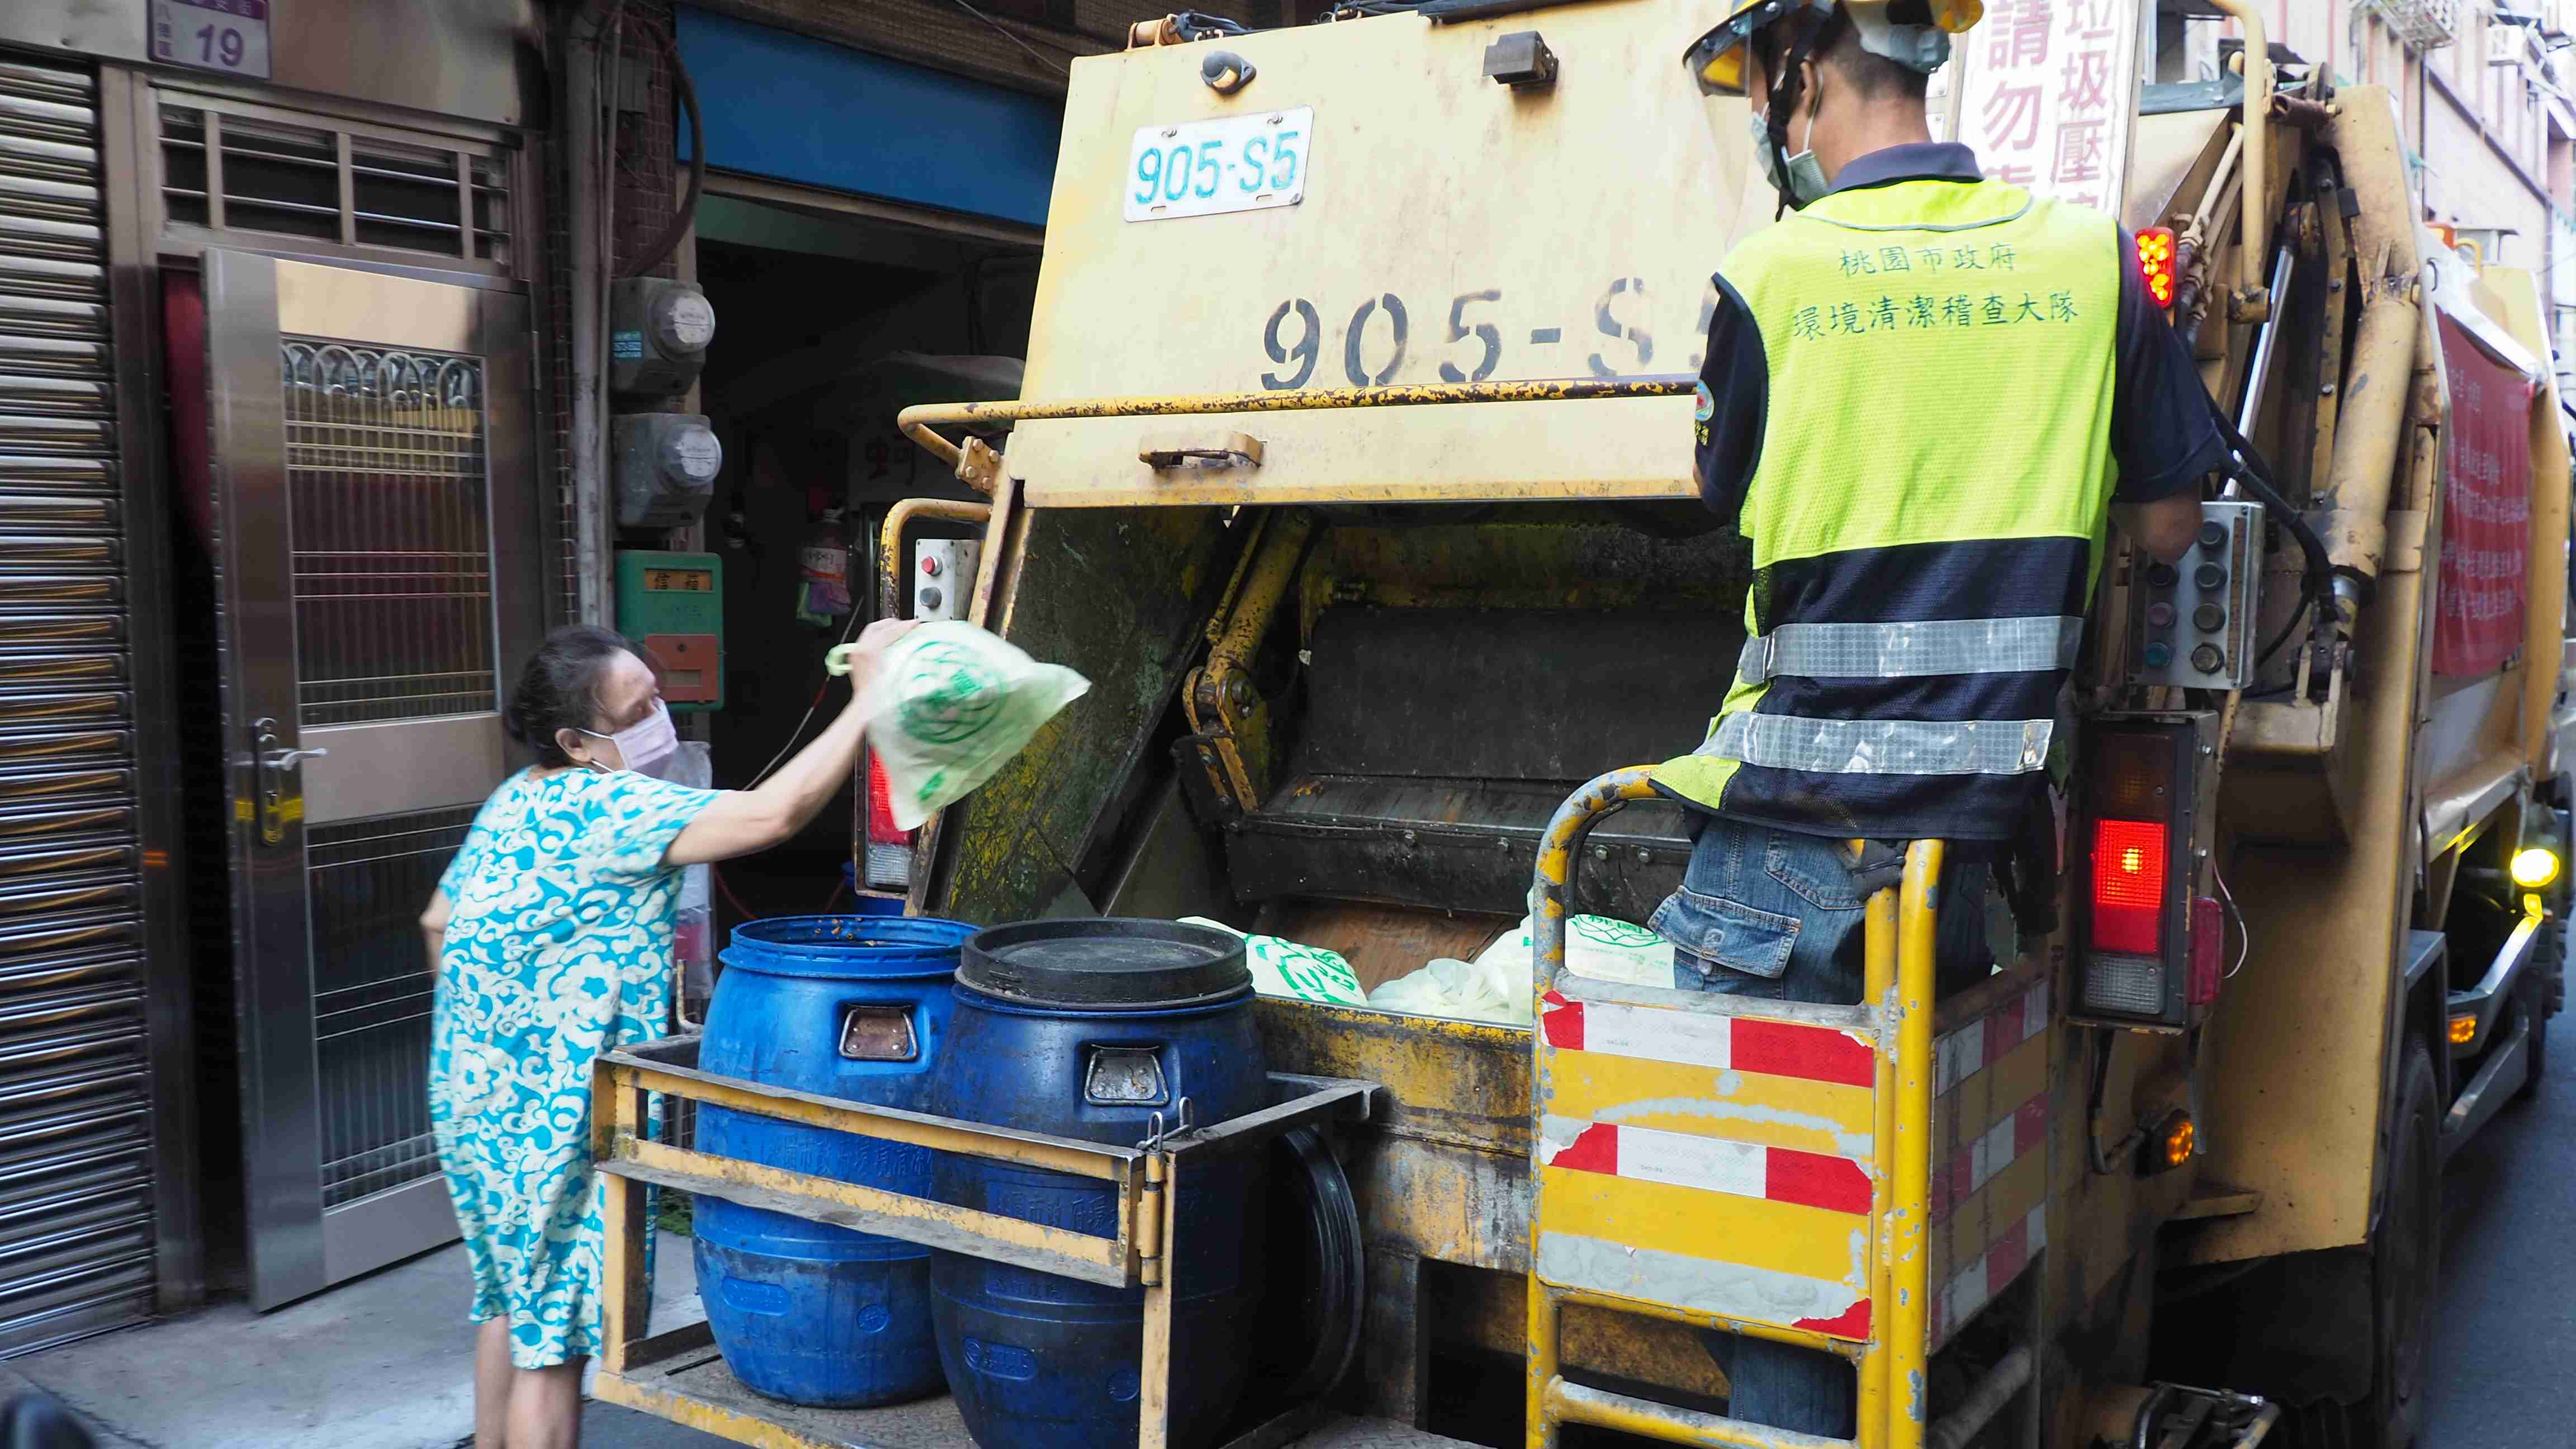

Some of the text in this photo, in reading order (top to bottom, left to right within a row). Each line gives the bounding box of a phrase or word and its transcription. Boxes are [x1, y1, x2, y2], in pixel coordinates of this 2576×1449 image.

[196, 23, 244, 67] 19
[1983, 0, 2053, 187] 請勿
[1135, 131, 1299, 204] 905-S5
[1838, 242, 2019, 278] 桃園市政府
[1792, 288, 2080, 342] 環境清潔稽查大隊
